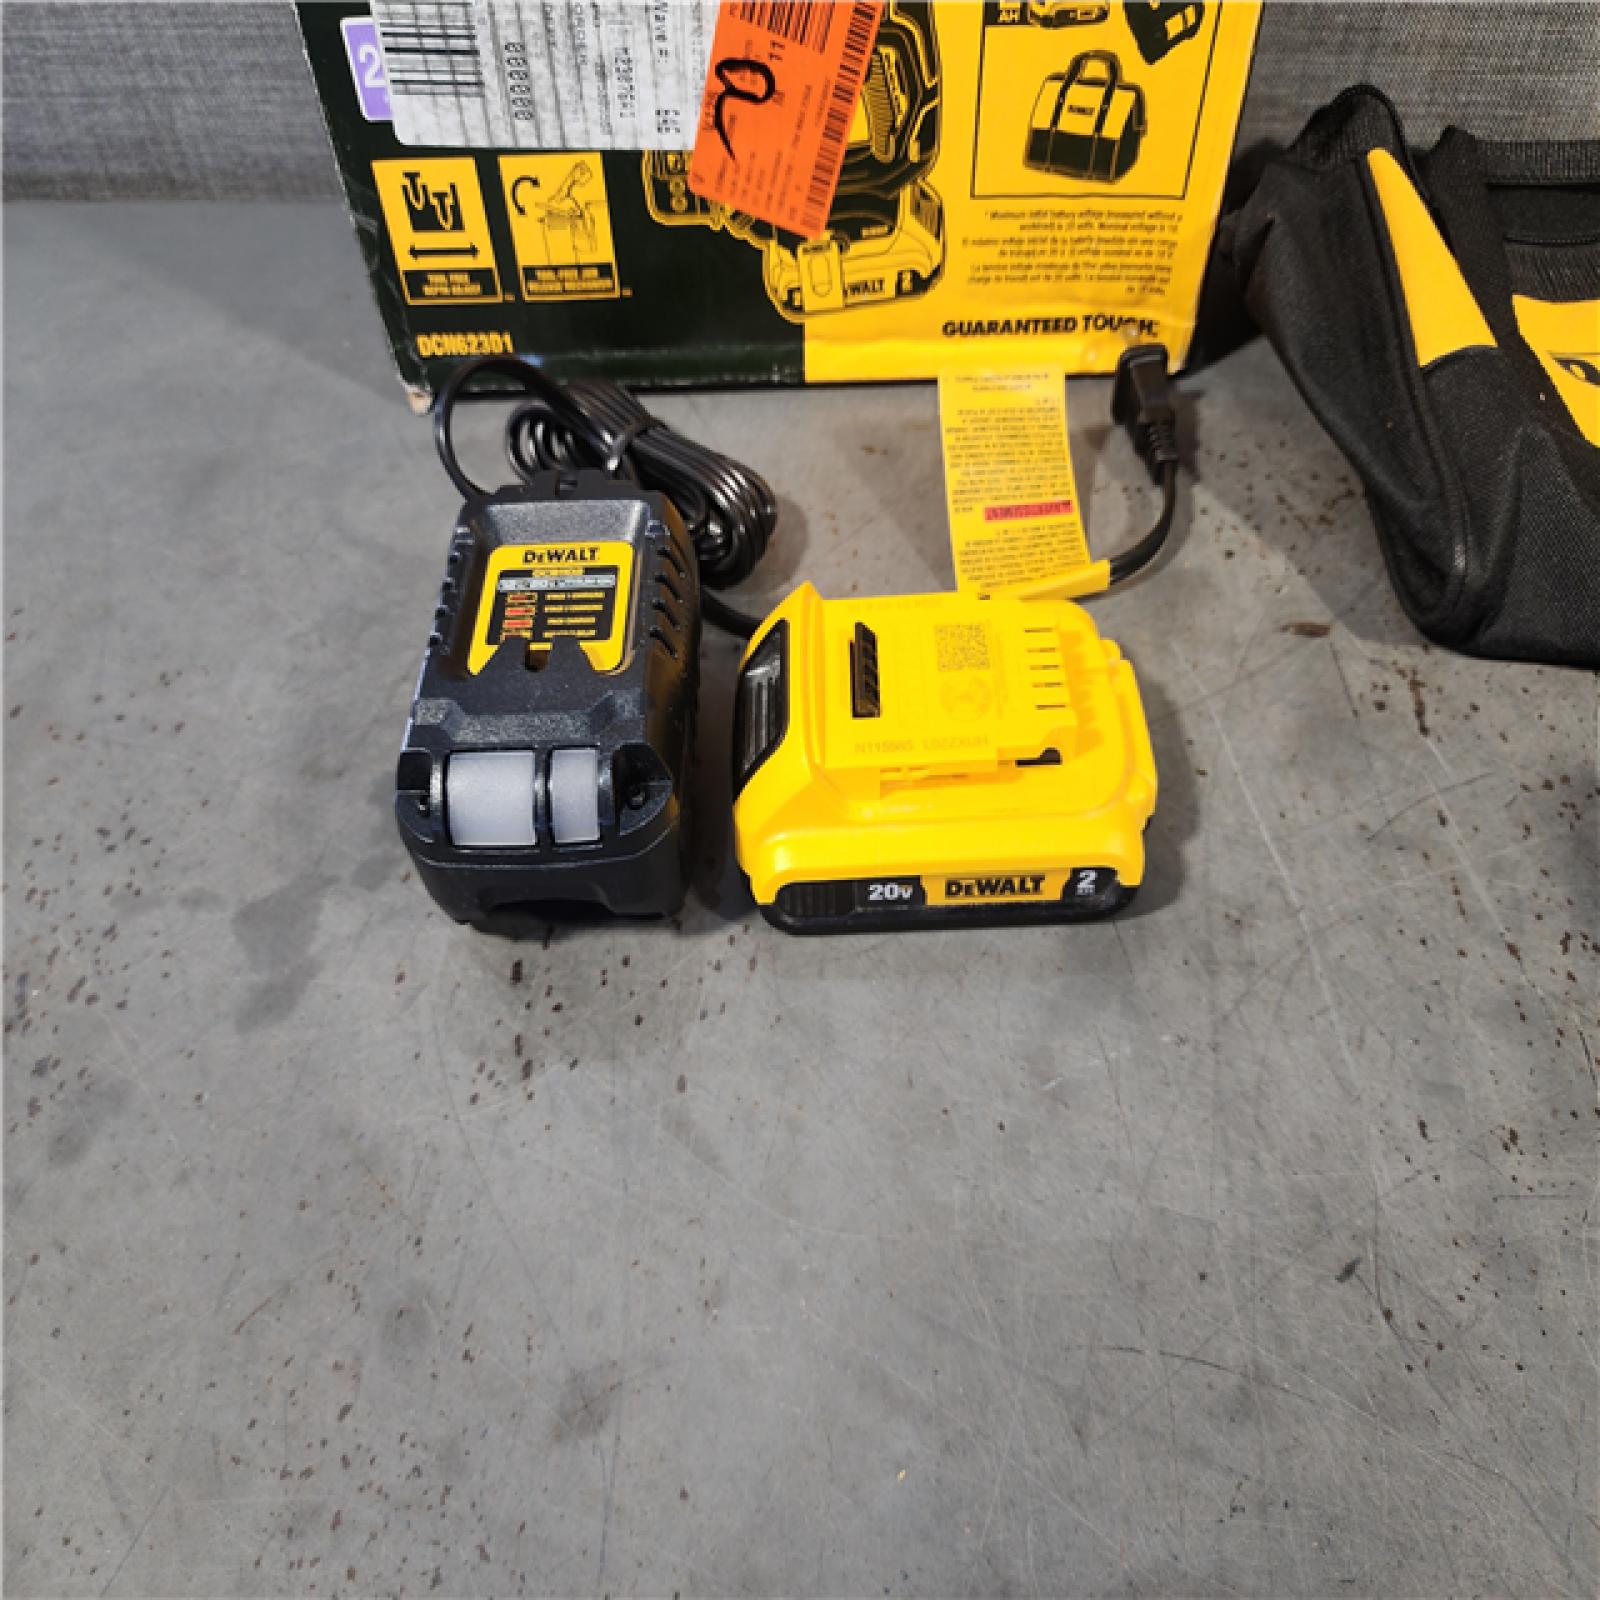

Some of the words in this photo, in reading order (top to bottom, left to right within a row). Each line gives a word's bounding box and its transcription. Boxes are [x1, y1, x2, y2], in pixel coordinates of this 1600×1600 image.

[846, 277, 886, 297] WALT
[942, 316, 1078, 338] GUARANTEED
[1077, 869, 1098, 888] 2
